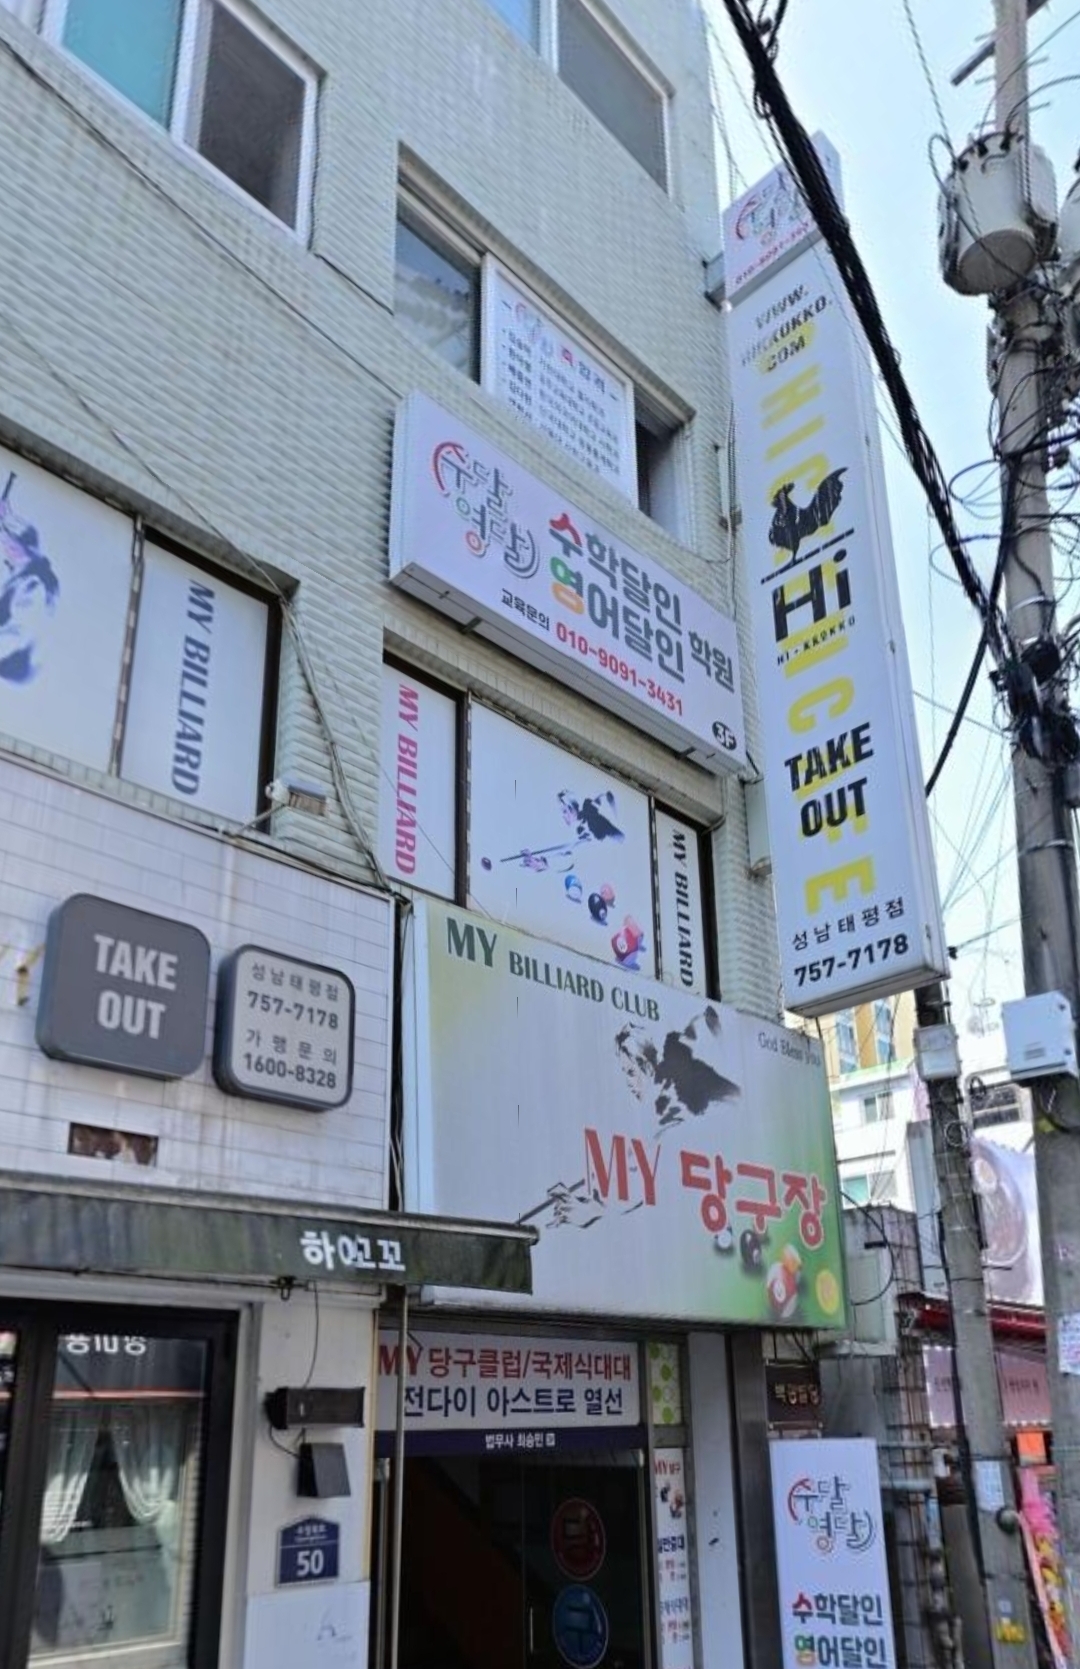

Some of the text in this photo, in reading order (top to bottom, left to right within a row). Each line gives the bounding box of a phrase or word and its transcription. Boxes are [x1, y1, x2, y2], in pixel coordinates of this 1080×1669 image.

[548, 512, 683, 636] 수학달인
[772, 548, 852, 644] Hi
[550, 556, 736, 693] 영어달인 학원
[501, 588, 684, 717] 교육문의 010-9091-3431
[171, 578, 216, 797] MY BILLIARD
[714, 723, 737, 750] 3F
[784, 722, 875, 792] TAKE
[395, 683, 420, 875] MY BILLIARD
[800, 778, 868, 839] OUT
[672, 829, 694, 988] MY BILLIARD
[791, 896, 905, 951] 성남태평점
[94, 934, 178, 991] TAKE
[252, 962, 339, 1003] 성남태평점
[447, 917, 660, 1022] MY BILLIARD CLUB
[793, 933, 909, 987] 757-7178
[97, 990, 166, 1040] OUT
[247, 990, 339, 1030] 757-7178
[758, 1031, 779, 1053] God
[243, 1053, 337, 1090] 1600-8328
[584, 1128, 827, 1250] MY 당구장
[378, 1345, 632, 1381] MY 당구클럽/국제식대대
[403, 1385, 624, 1418] 전다이 아스트로 열선
[296, 1549, 325, 1577] 50
[792, 1591, 884, 1627] 수학달인
[794, 1633, 888, 1669] 영어달인
